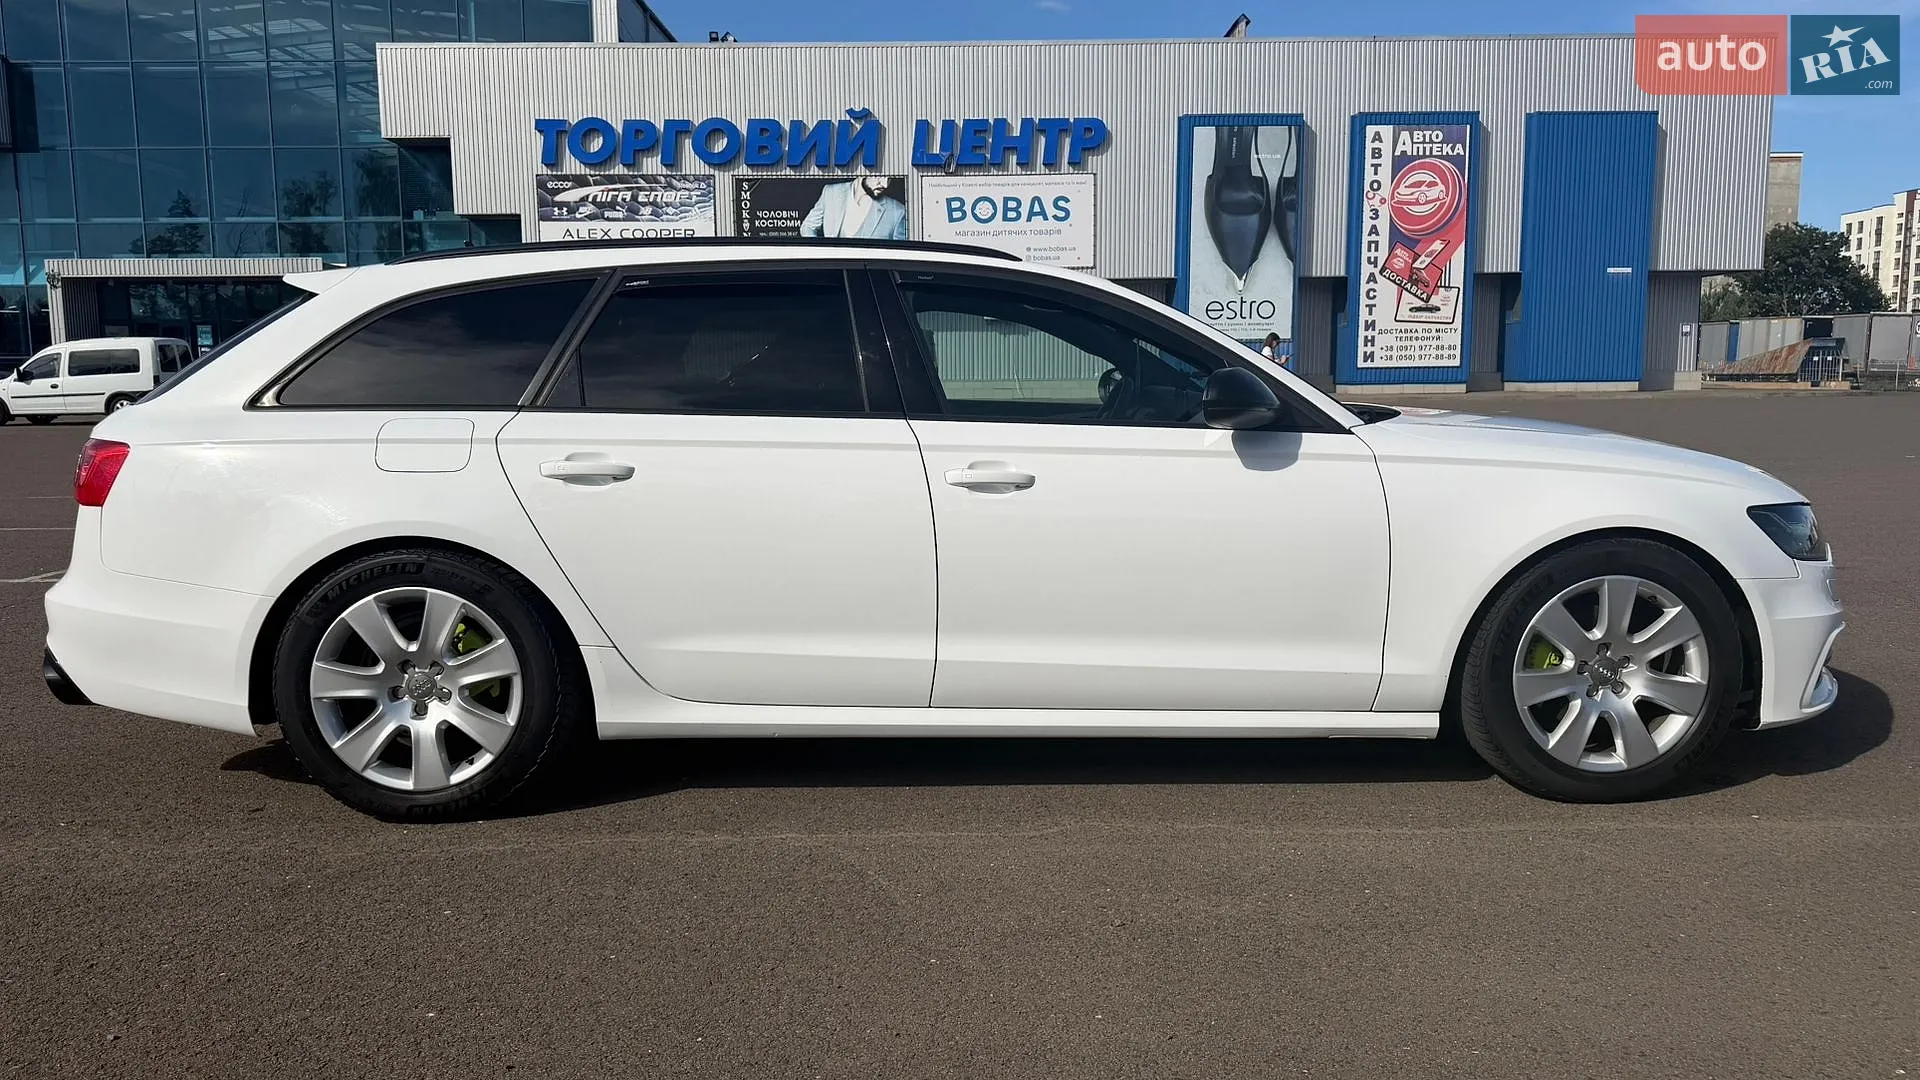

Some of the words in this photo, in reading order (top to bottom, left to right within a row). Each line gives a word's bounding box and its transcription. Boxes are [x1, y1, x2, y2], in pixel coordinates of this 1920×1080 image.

[535, 108, 881, 167] ТОРГОВИЙ
[911, 117, 1108, 170] ЦЕНТР
[756, 210, 799, 218] ЧОЛОВІЧІ
[945, 195, 1072, 224] BOBAS
[755, 219, 801, 228] КОСТЮМИ
[562, 228, 612, 240] ALEX
[619, 228, 696, 239] COOPER
[955, 229, 991, 237] магазин
[992, 229, 1028, 238] дитячих
[1029, 227, 1062, 237] товарів
[1382, 268, 1429, 301] ДОСТАВКА
[1205, 296, 1276, 320] estro
[1396, 344, 1416, 353] (097)
[1395, 354, 1416, 362] (050)
[327, 562, 419, 601] MICHELIN
